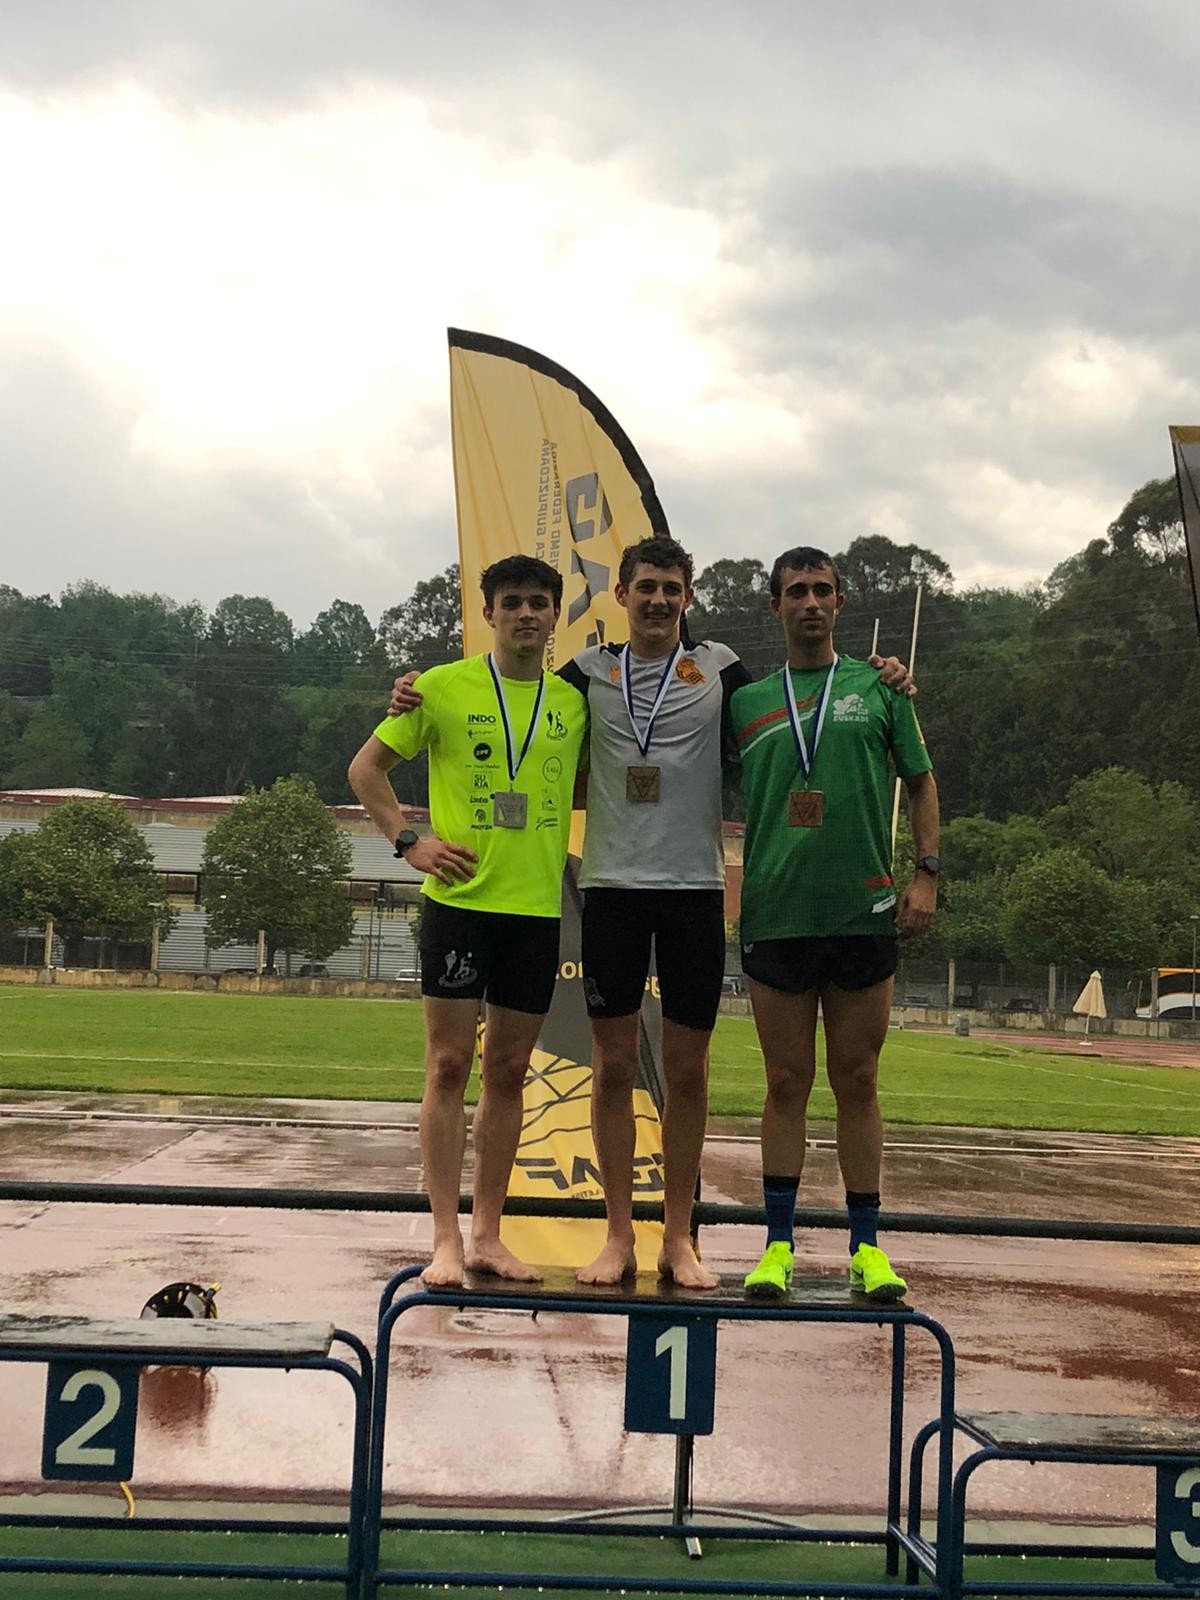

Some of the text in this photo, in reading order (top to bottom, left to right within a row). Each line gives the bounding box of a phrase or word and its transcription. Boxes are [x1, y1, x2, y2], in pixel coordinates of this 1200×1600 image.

[468, 714, 496, 723] INDO
[55, 1369, 121, 1466] 2
[655, 1326, 688, 1420] 1
